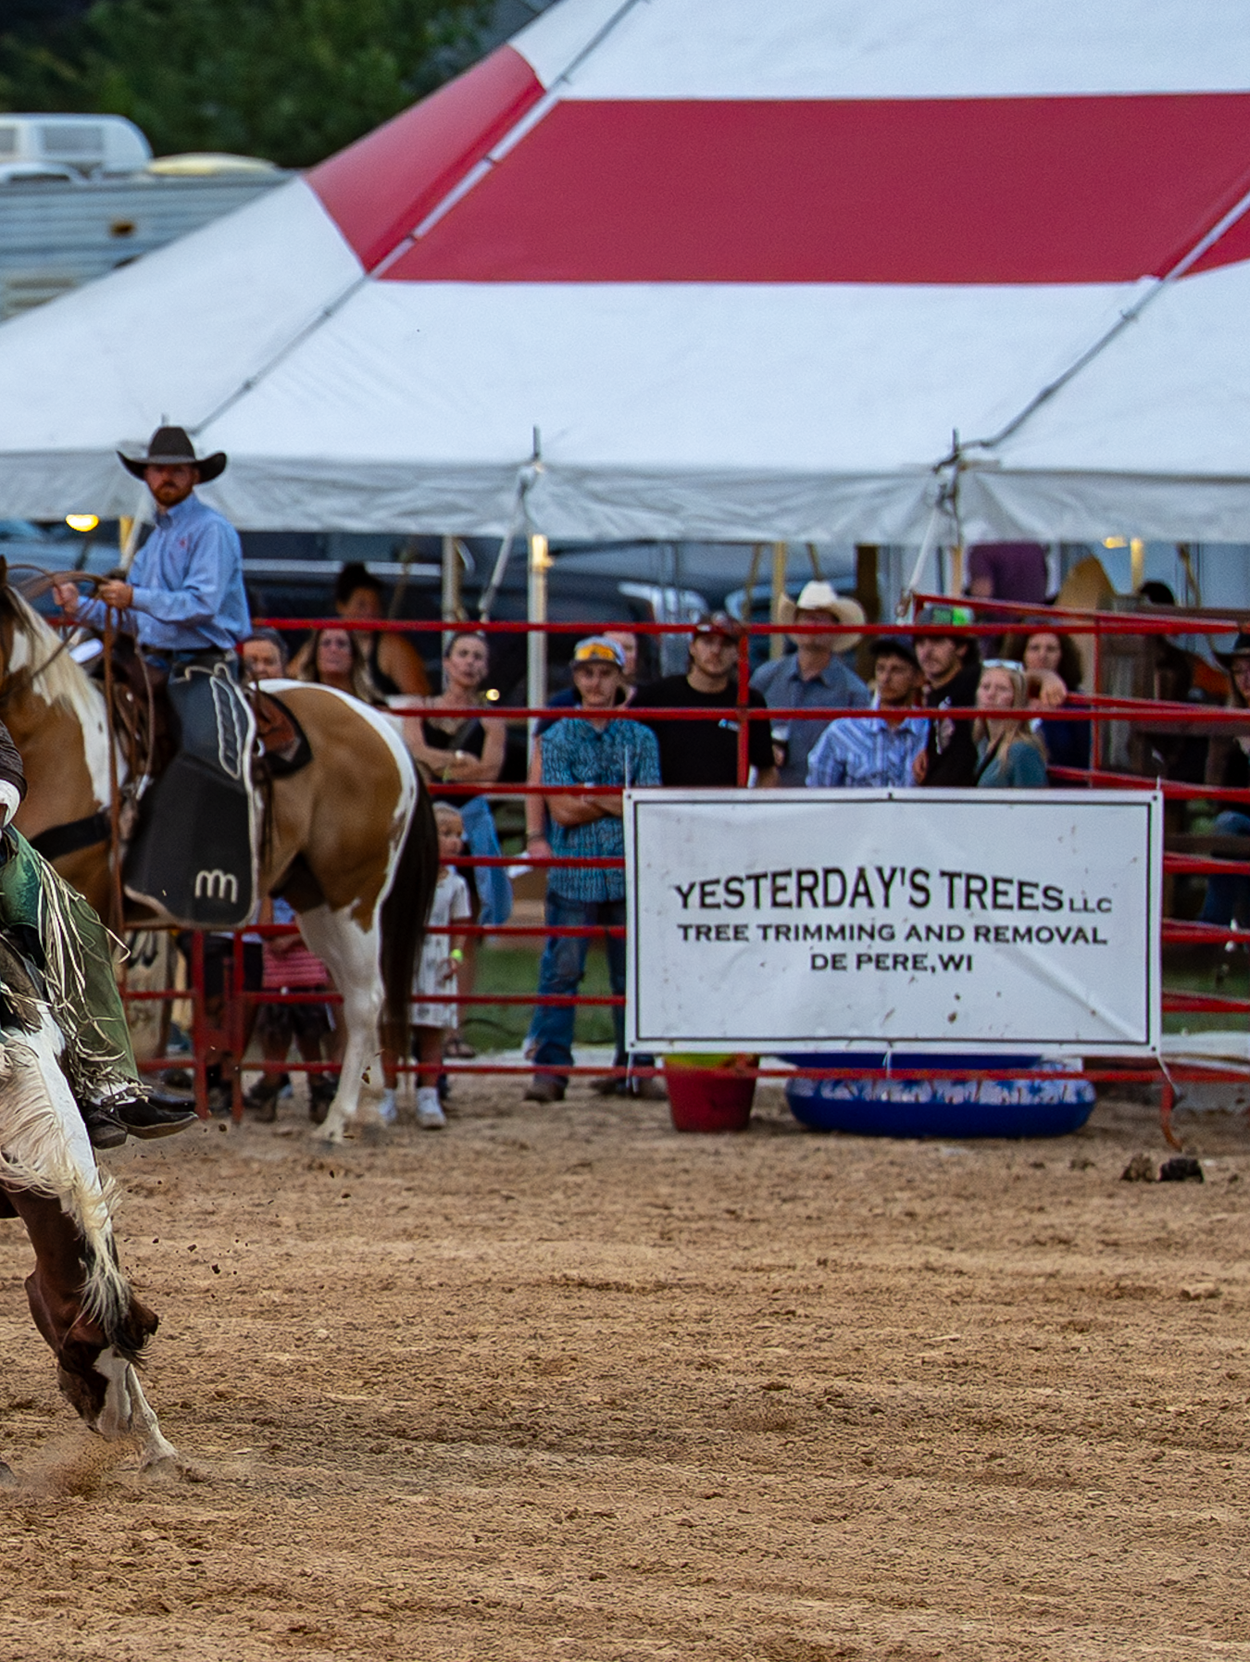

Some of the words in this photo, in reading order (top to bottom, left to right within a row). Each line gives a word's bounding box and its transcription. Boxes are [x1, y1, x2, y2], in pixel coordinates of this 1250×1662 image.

[674, 866, 931, 911] YESTERDAY'S
[939, 869, 1064, 912] TREES
[1068, 897, 1112, 913] LLC
[677, 923, 749, 942] TREE
[756, 923, 896, 942] TRIMMING
[904, 924, 965, 942] AND
[973, 925, 1108, 945] REMOVAL
[810, 953, 847, 971] DE
